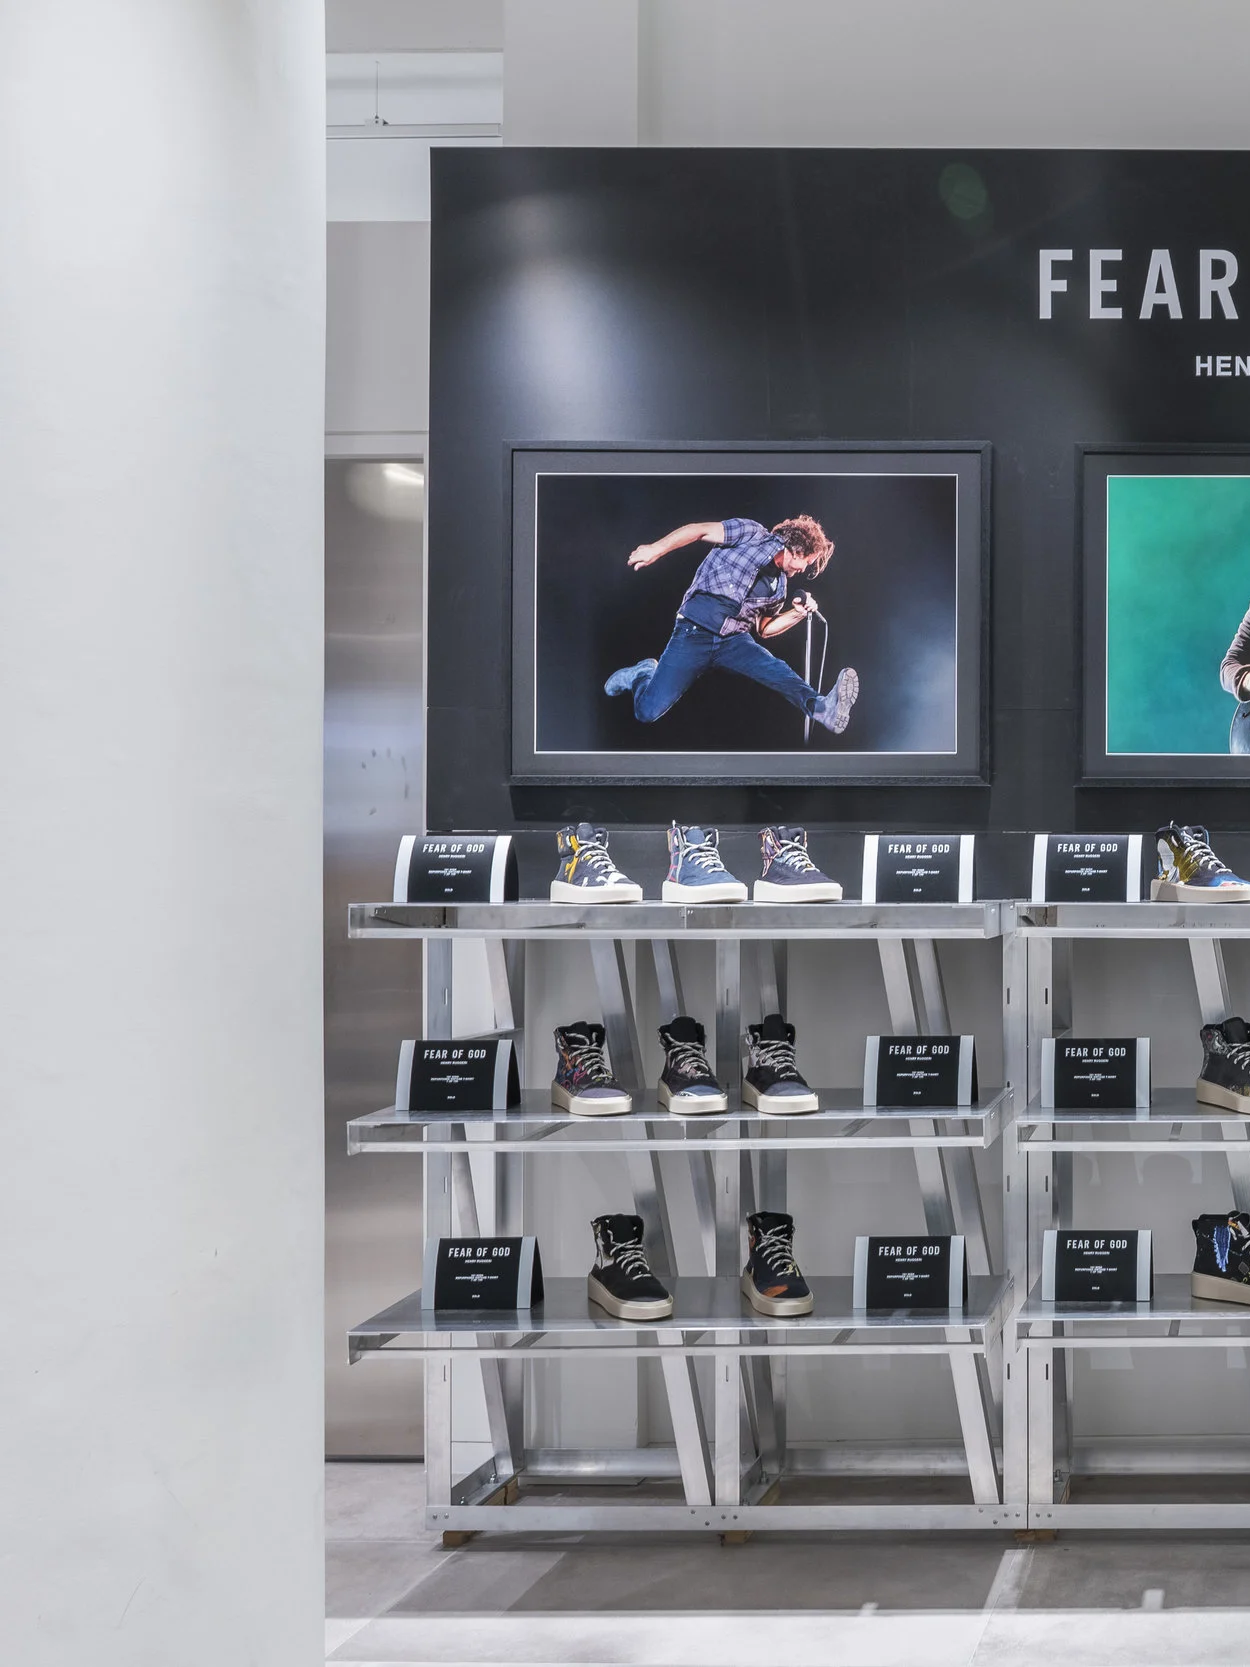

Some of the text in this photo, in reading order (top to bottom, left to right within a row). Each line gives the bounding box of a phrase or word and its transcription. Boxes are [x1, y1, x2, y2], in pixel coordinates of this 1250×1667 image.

[1039, 249, 1239, 320] FEAR
[422, 843, 485, 853] FEAR OF GOD
[887, 843, 950, 854] FEAR OF GOD
[1057, 843, 1118, 853] FEAR OF GOD
[423, 1049, 487, 1060] FEAR OF GOD
[888, 1044, 950, 1055] FEAR OF GOD
[1065, 1047, 1127, 1057] FEAR OF GOD
[1066, 1239, 1128, 1250] FEAR OF GOD
[448, 1246, 511, 1258] FEAR OF GOD
[878, 1245, 940, 1257] FEAR OF GOD
